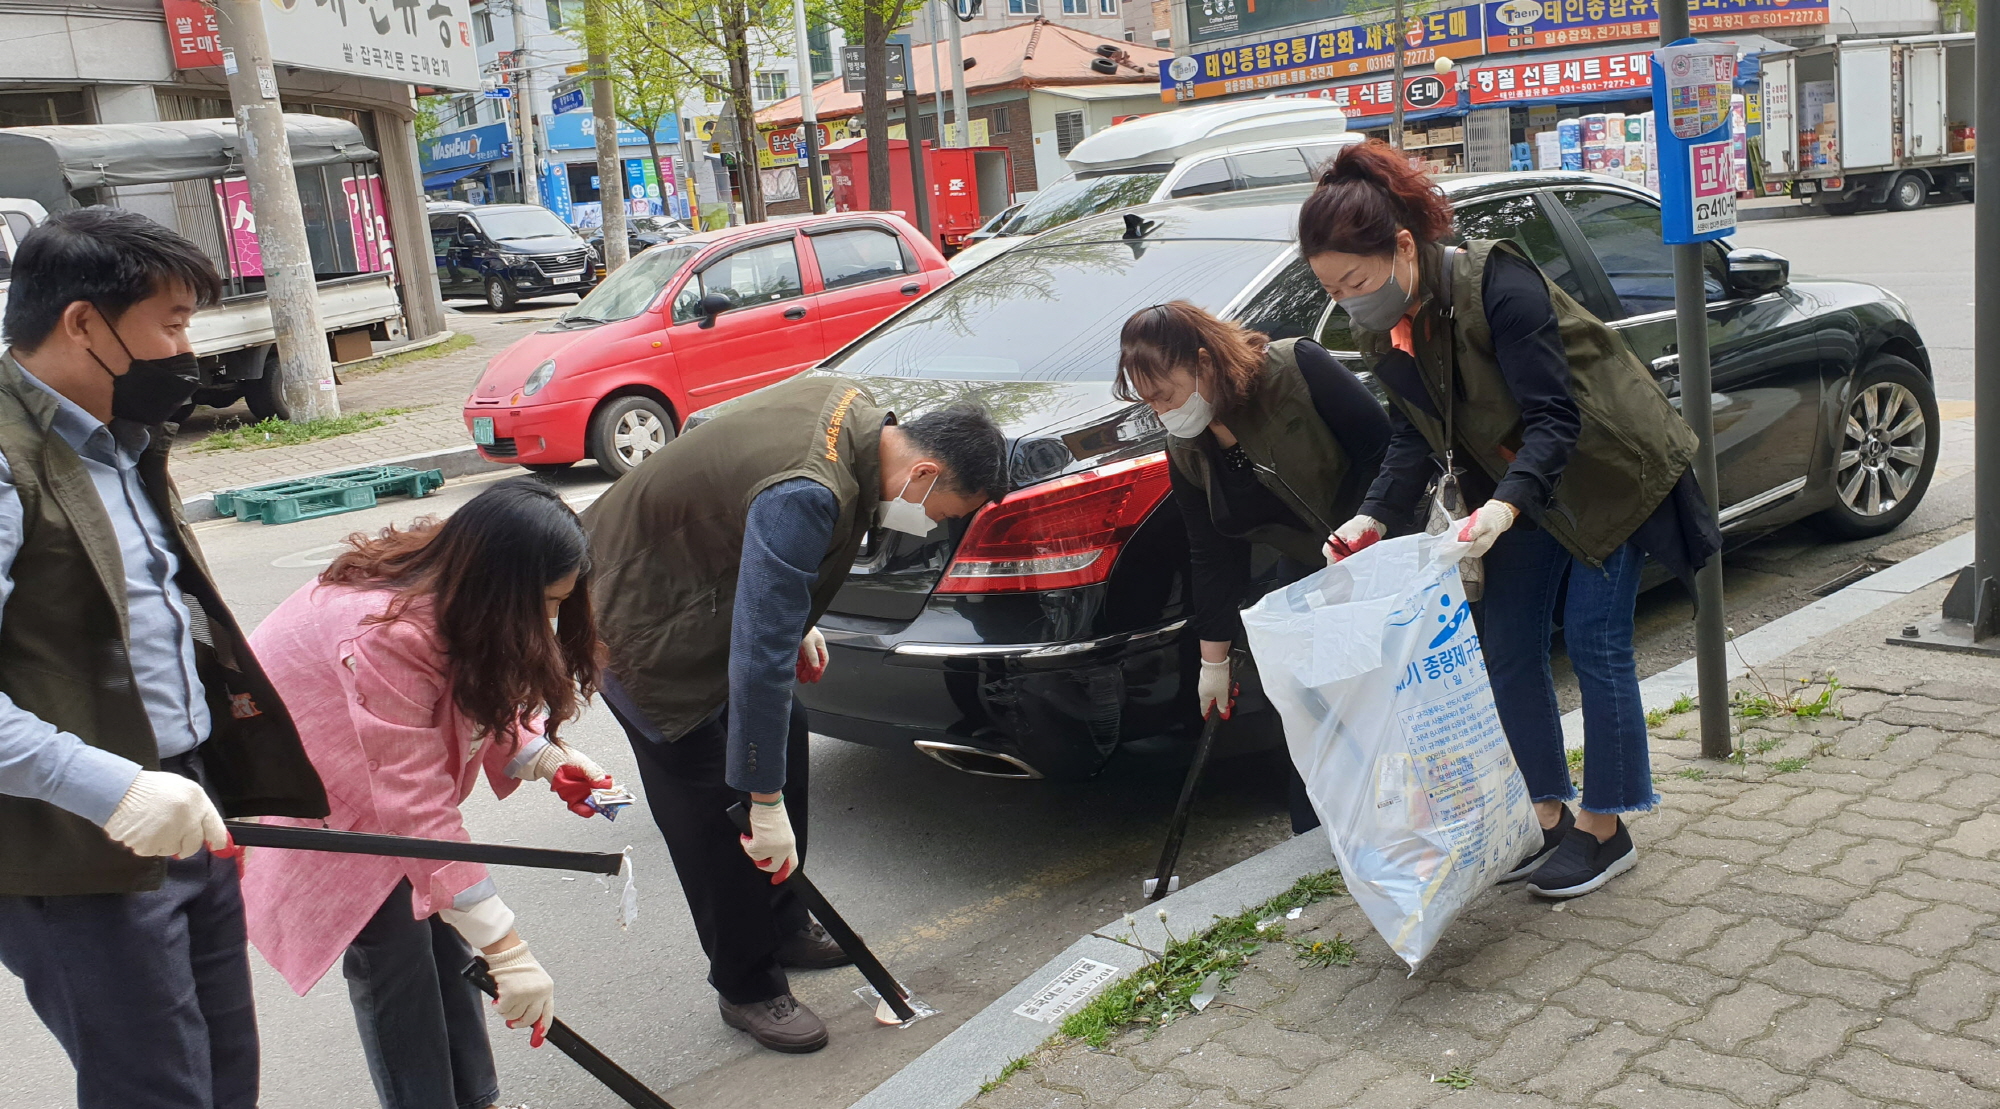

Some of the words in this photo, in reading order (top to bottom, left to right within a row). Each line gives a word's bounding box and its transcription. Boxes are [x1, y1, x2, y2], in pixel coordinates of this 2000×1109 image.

[1503, 5, 1539, 24] Taein
[1713, 14, 1743, 28] 화장지
[1428, 10, 1467, 41] 도매
[411, 54, 450, 77] 도매업체
[1172, 61, 1196, 78] Taein
[1477, 69, 1515, 93] 명절
[1522, 59, 1601, 87] 선물세트
[1609, 54, 1647, 77] 도매
[1411, 82, 1439, 101] 도매
